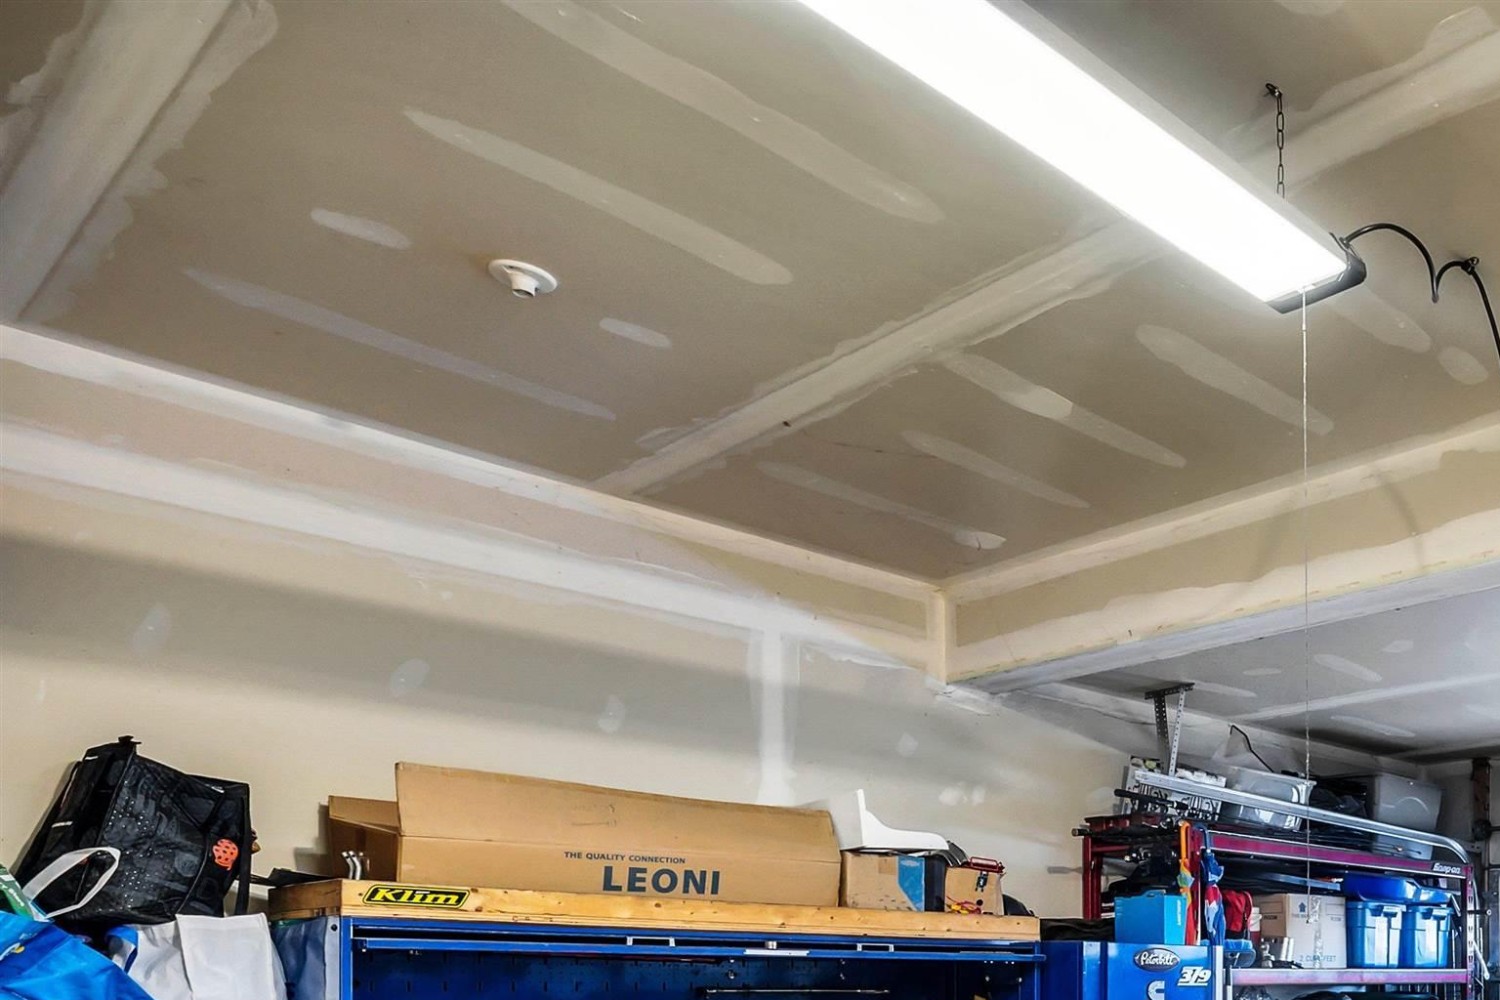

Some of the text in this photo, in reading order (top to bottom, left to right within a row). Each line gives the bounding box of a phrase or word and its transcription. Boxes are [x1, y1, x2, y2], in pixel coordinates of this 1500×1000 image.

[564, 851, 686, 864] THE QUALITY CONNECTION
[602, 865, 720, 895] LEONI
[1140, 951, 1174, 966] Peterbilt
[1178, 966, 1212, 986] 379
